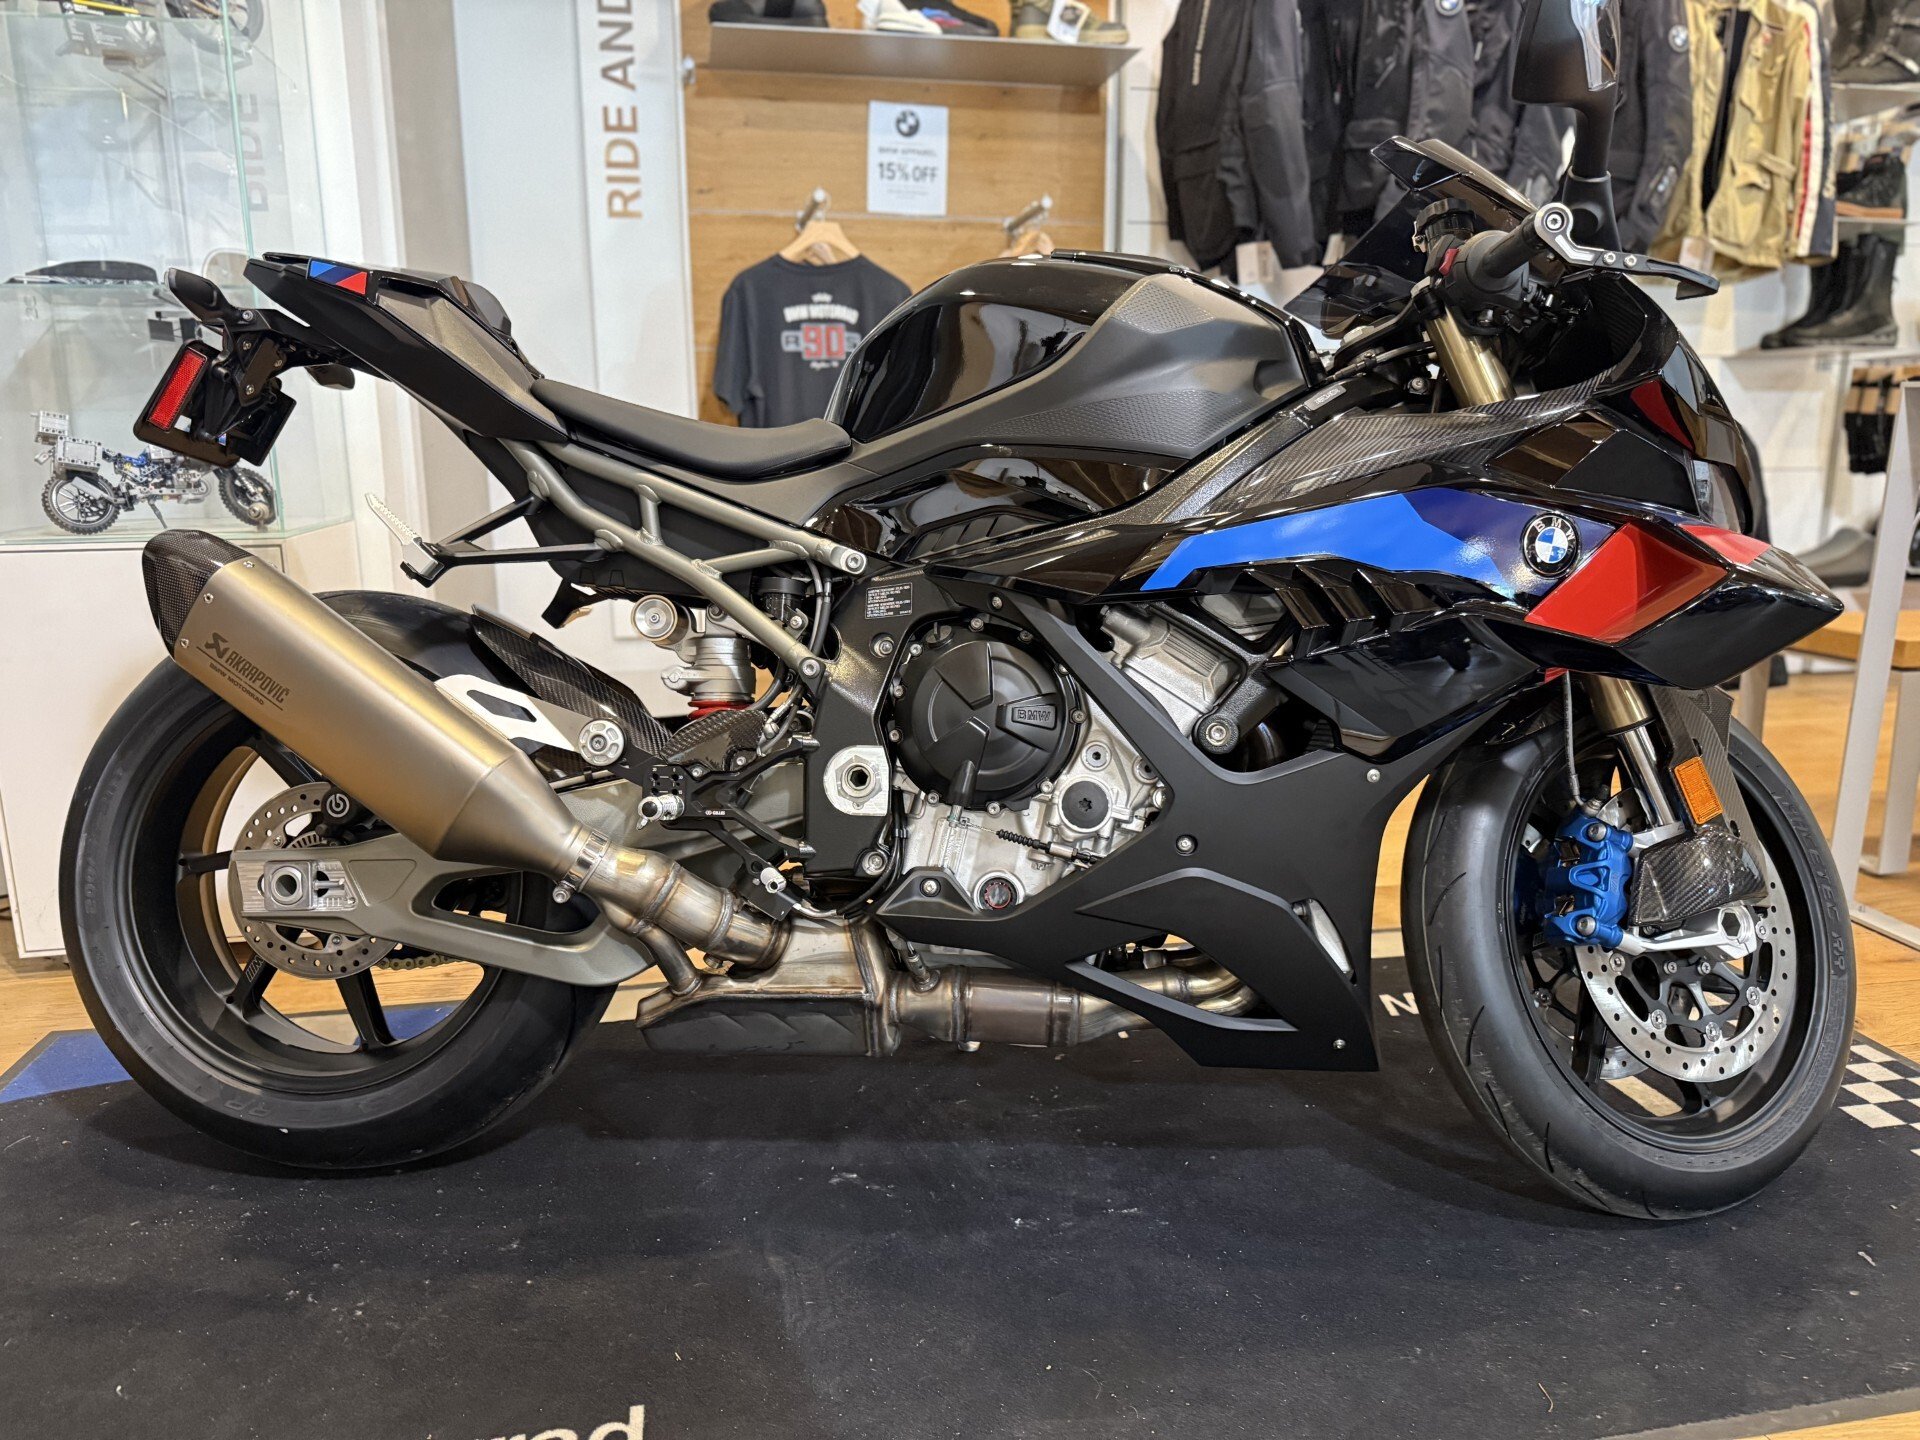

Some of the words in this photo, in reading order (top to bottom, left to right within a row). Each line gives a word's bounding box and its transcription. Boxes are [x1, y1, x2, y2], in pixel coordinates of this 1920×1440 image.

[602, 105, 643, 219] RIDE
[878, 162, 909, 181] 15%
[911, 165, 939, 183] OFF
[802, 324, 845, 359] 90
[1533, 516, 1577, 552] BMW
[209, 662, 227, 678] BMW
[227, 675, 264, 706] MOTORRAD
[1017, 709, 1051, 721] BMW
